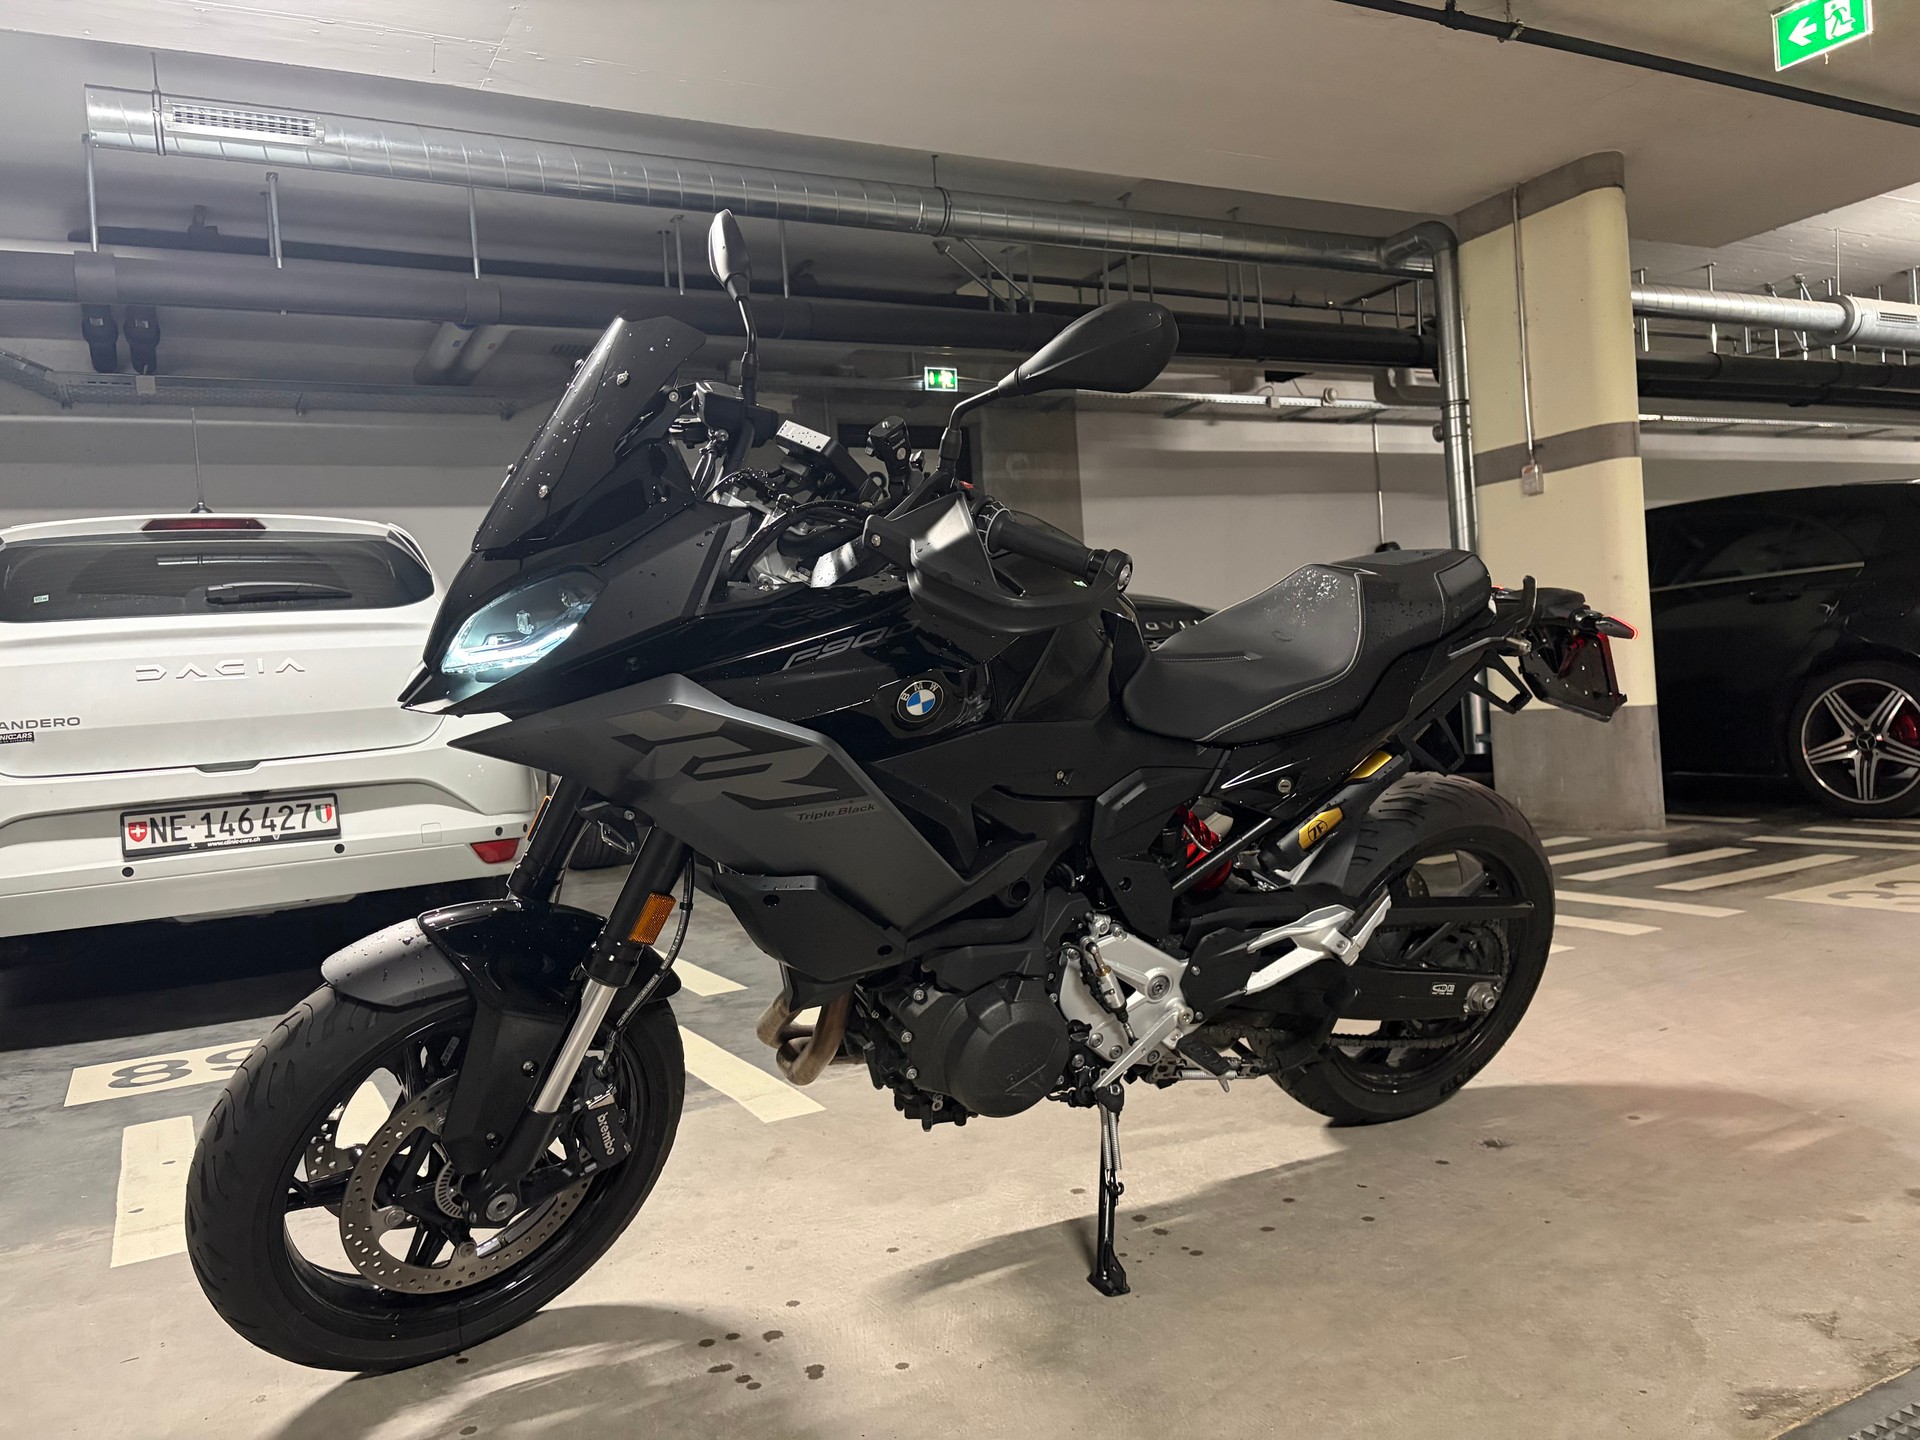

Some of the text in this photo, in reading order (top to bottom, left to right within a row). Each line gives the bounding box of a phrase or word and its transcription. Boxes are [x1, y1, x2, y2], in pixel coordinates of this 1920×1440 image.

[782, 619, 921, 670] F900
[135, 656, 306, 682] DACIA
[797, 803, 875, 821] Triple Black
[596, 1111, 616, 1156] brembo
